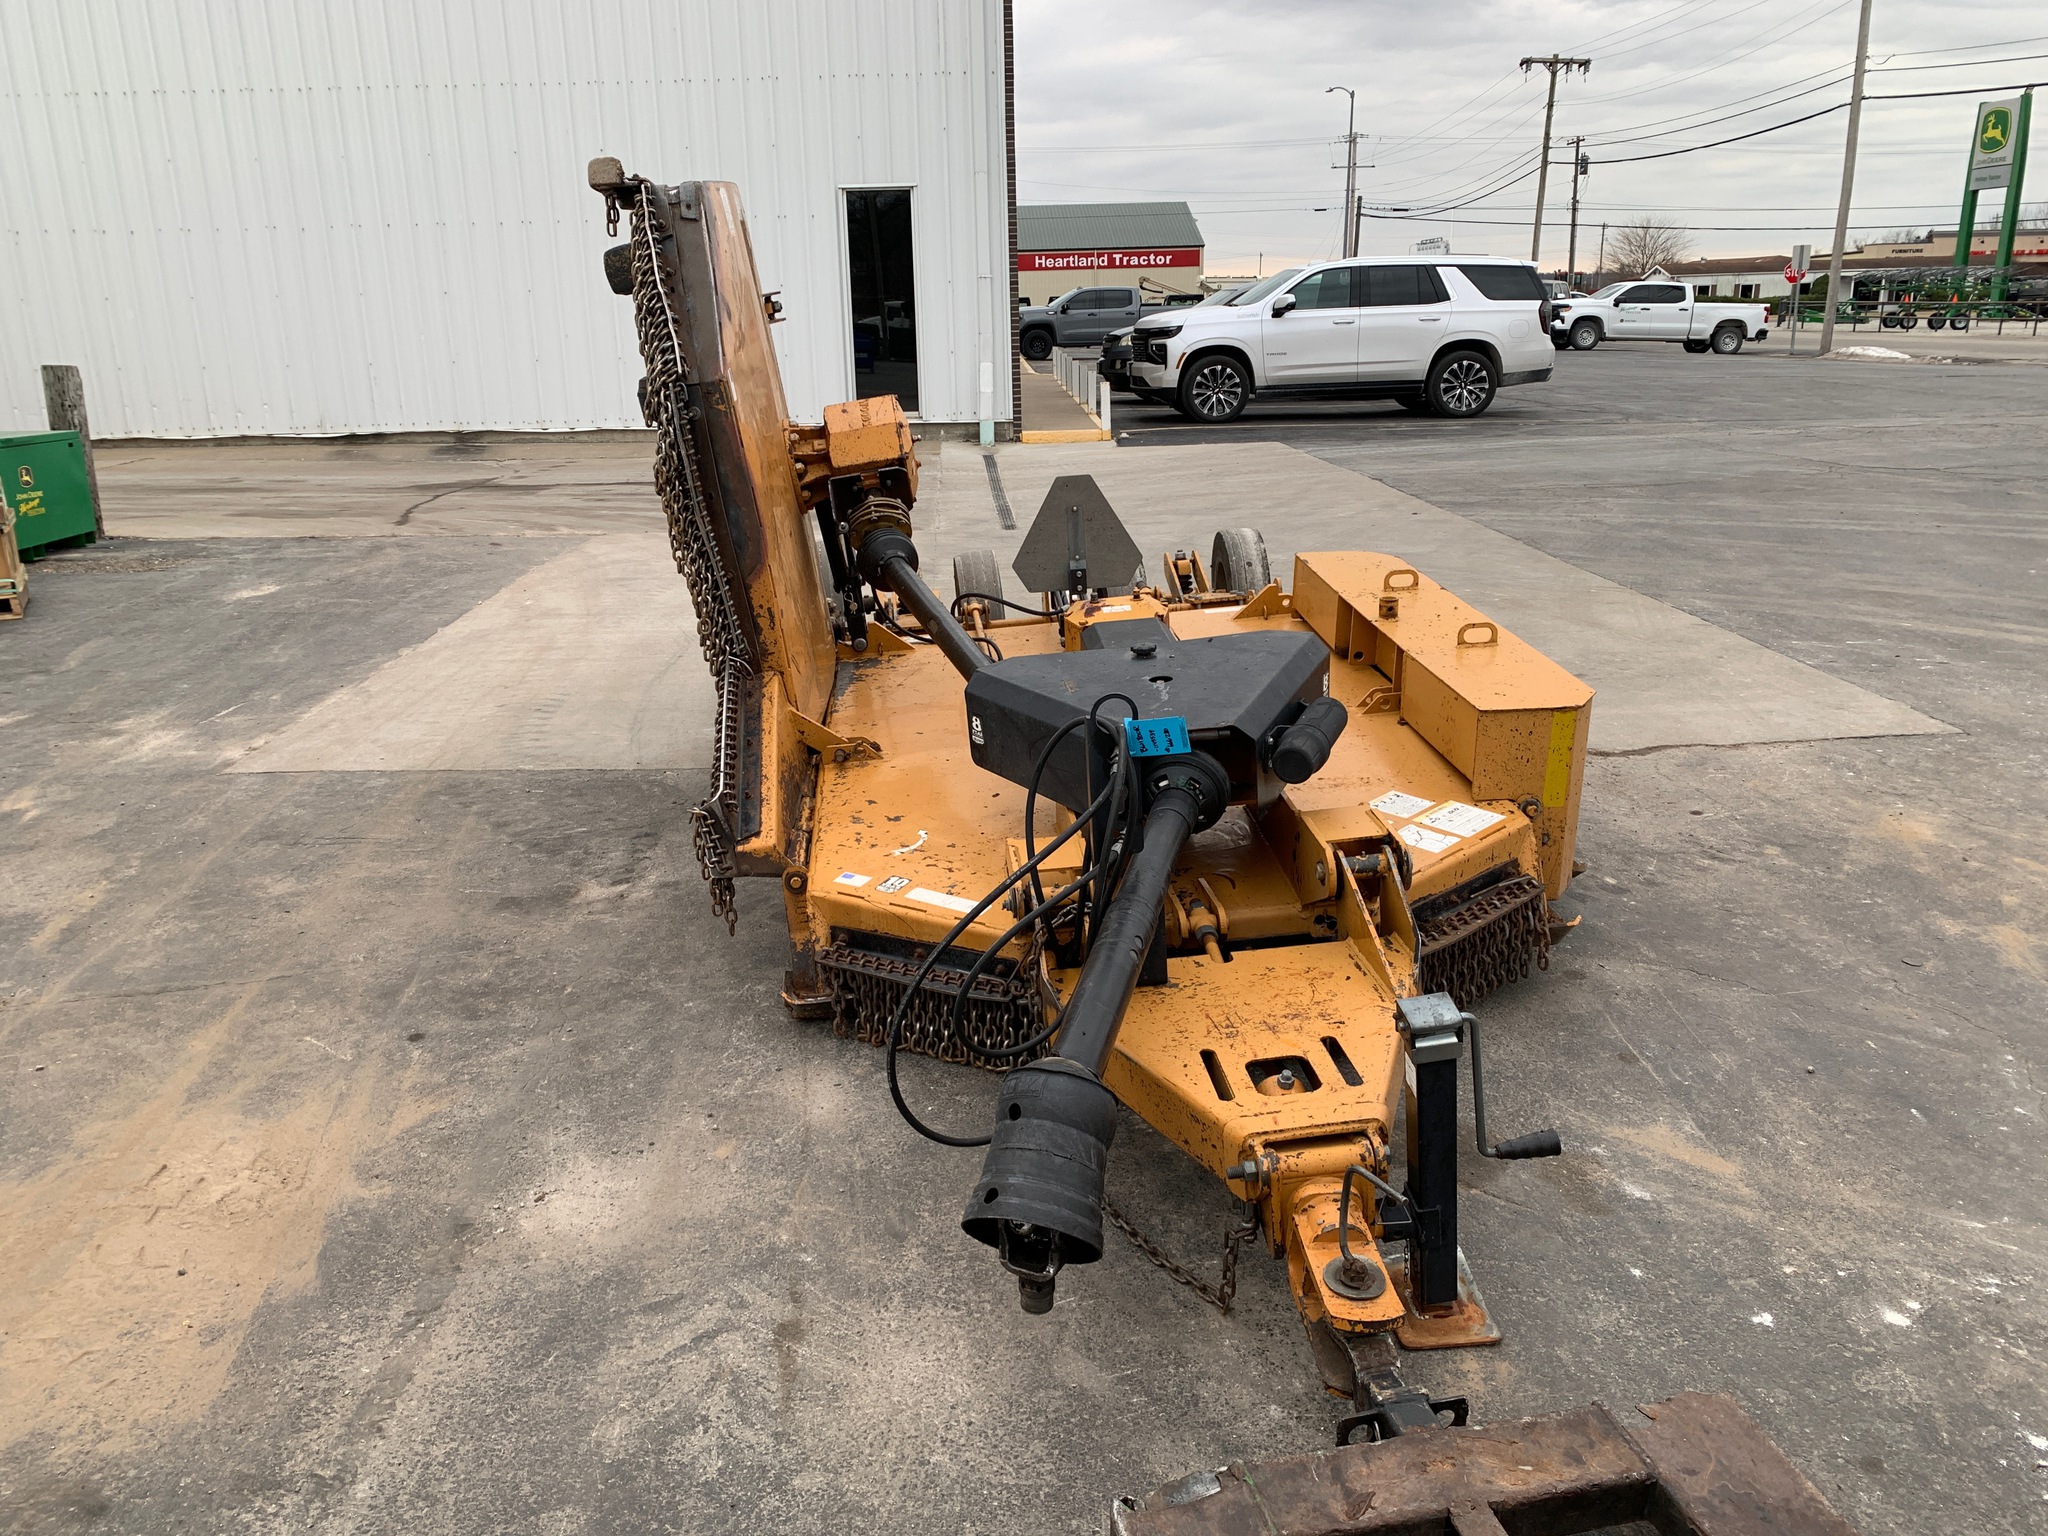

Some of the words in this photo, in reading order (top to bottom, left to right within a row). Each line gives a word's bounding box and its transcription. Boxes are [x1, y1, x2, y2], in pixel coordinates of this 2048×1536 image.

[1034, 254, 1108, 268] Heartland
[1112, 253, 1173, 266] Tractor
[971, 715, 982, 731] 8
